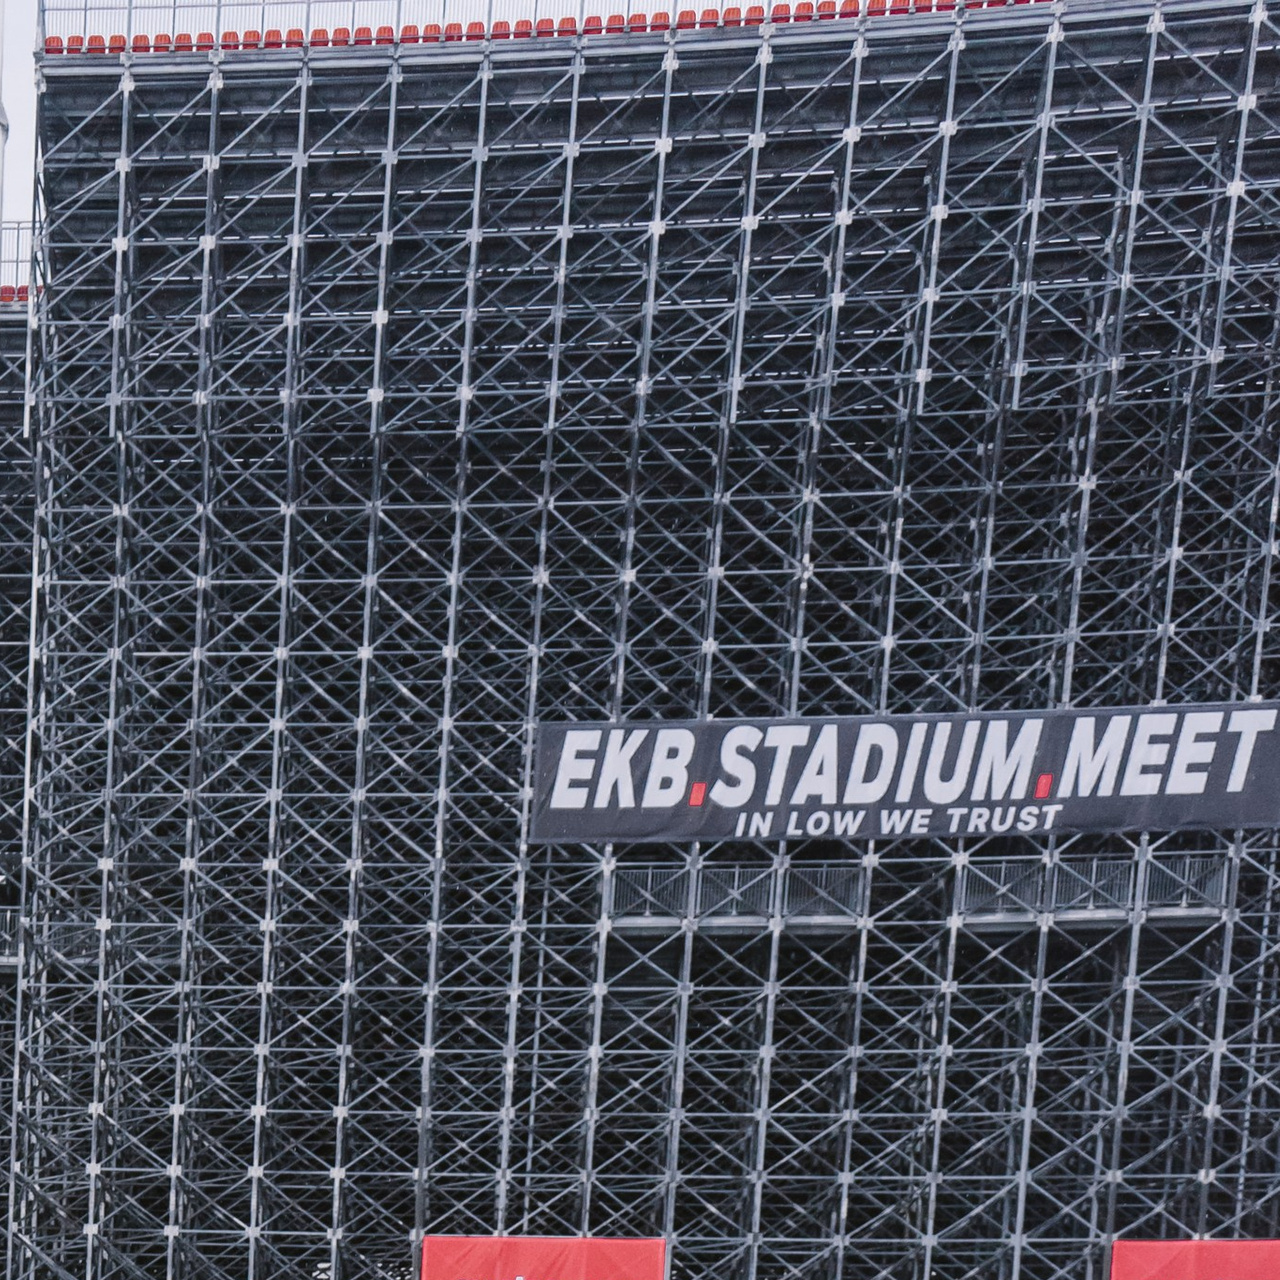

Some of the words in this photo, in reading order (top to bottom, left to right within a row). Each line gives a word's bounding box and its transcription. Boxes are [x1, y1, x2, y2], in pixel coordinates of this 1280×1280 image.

[734, 810, 774, 839] IN
[785, 809, 866, 837] LOW
[879, 808, 933, 835] WE
[946, 804, 1063, 834] TRUST
